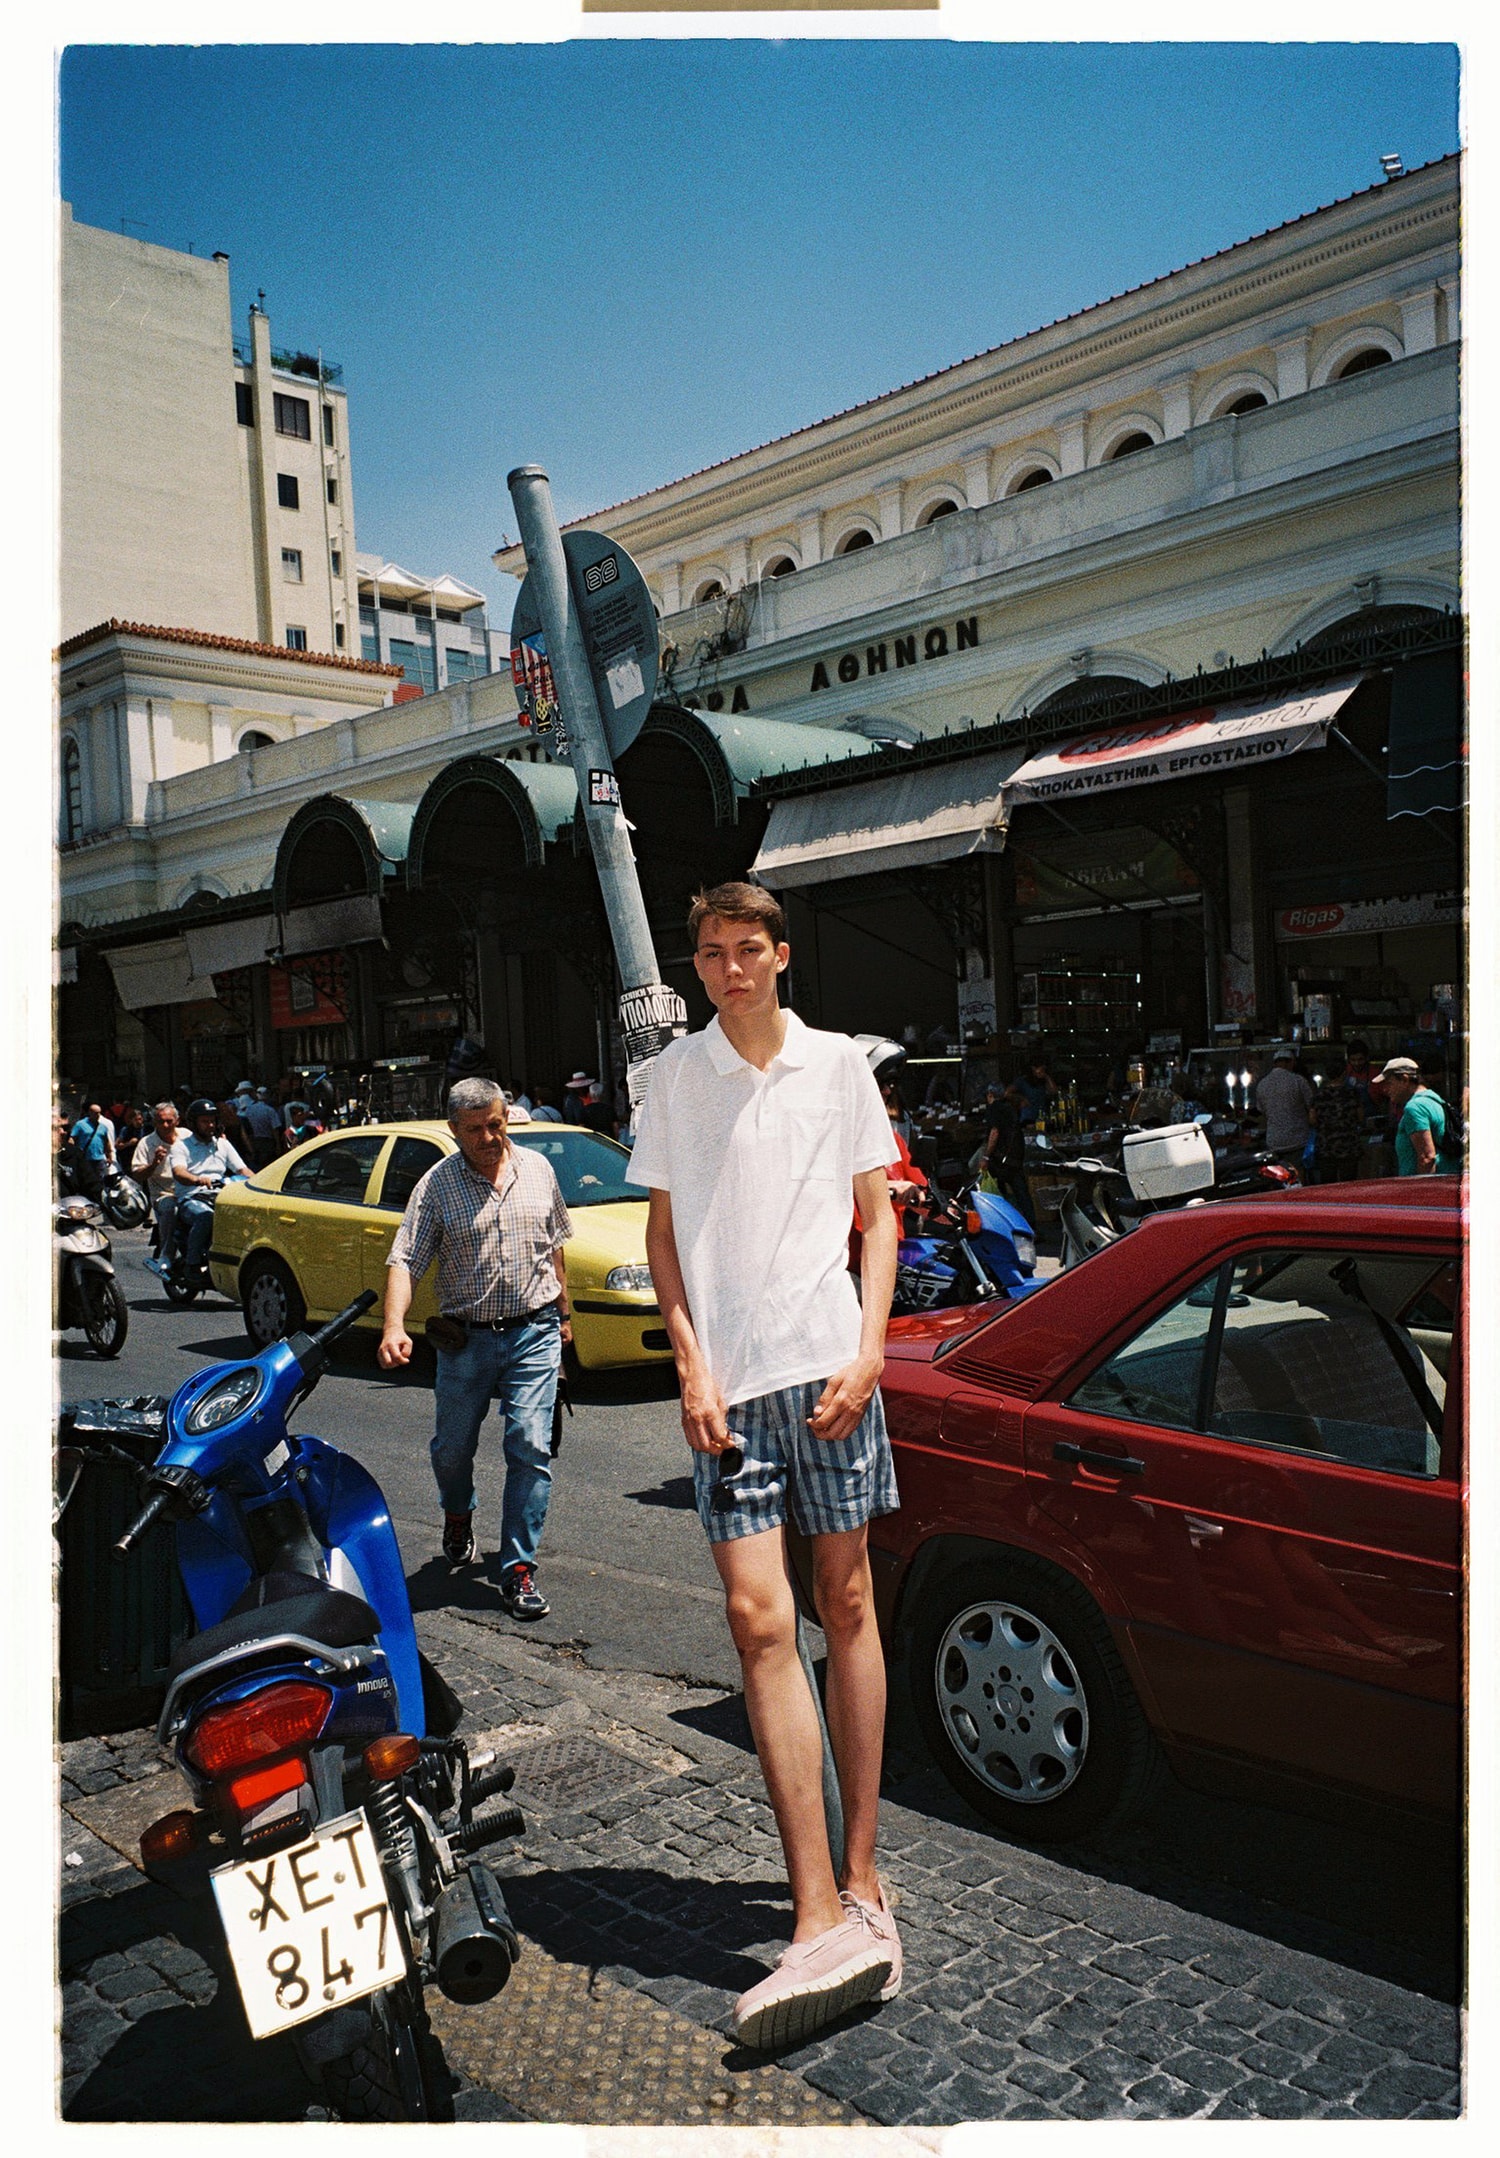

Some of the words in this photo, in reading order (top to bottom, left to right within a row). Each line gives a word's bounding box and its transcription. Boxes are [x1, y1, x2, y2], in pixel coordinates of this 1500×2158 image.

[810, 615, 980, 692] ΑΘΗΝΩΝ
[1211, 701, 1319, 738] ΚΑΡΠΟΙ
[1030, 762, 1160, 798] ΥΠΟΚΑΤΑΣΤΗΜΑ
[1169, 737, 1289, 773] ΕΡΓΟΣΤΑΣΙΟΥ
[1288, 906, 1339, 929] Rigas
[356, 1676, 390, 1695] Innova
[266, 1902, 389, 2010] 847
